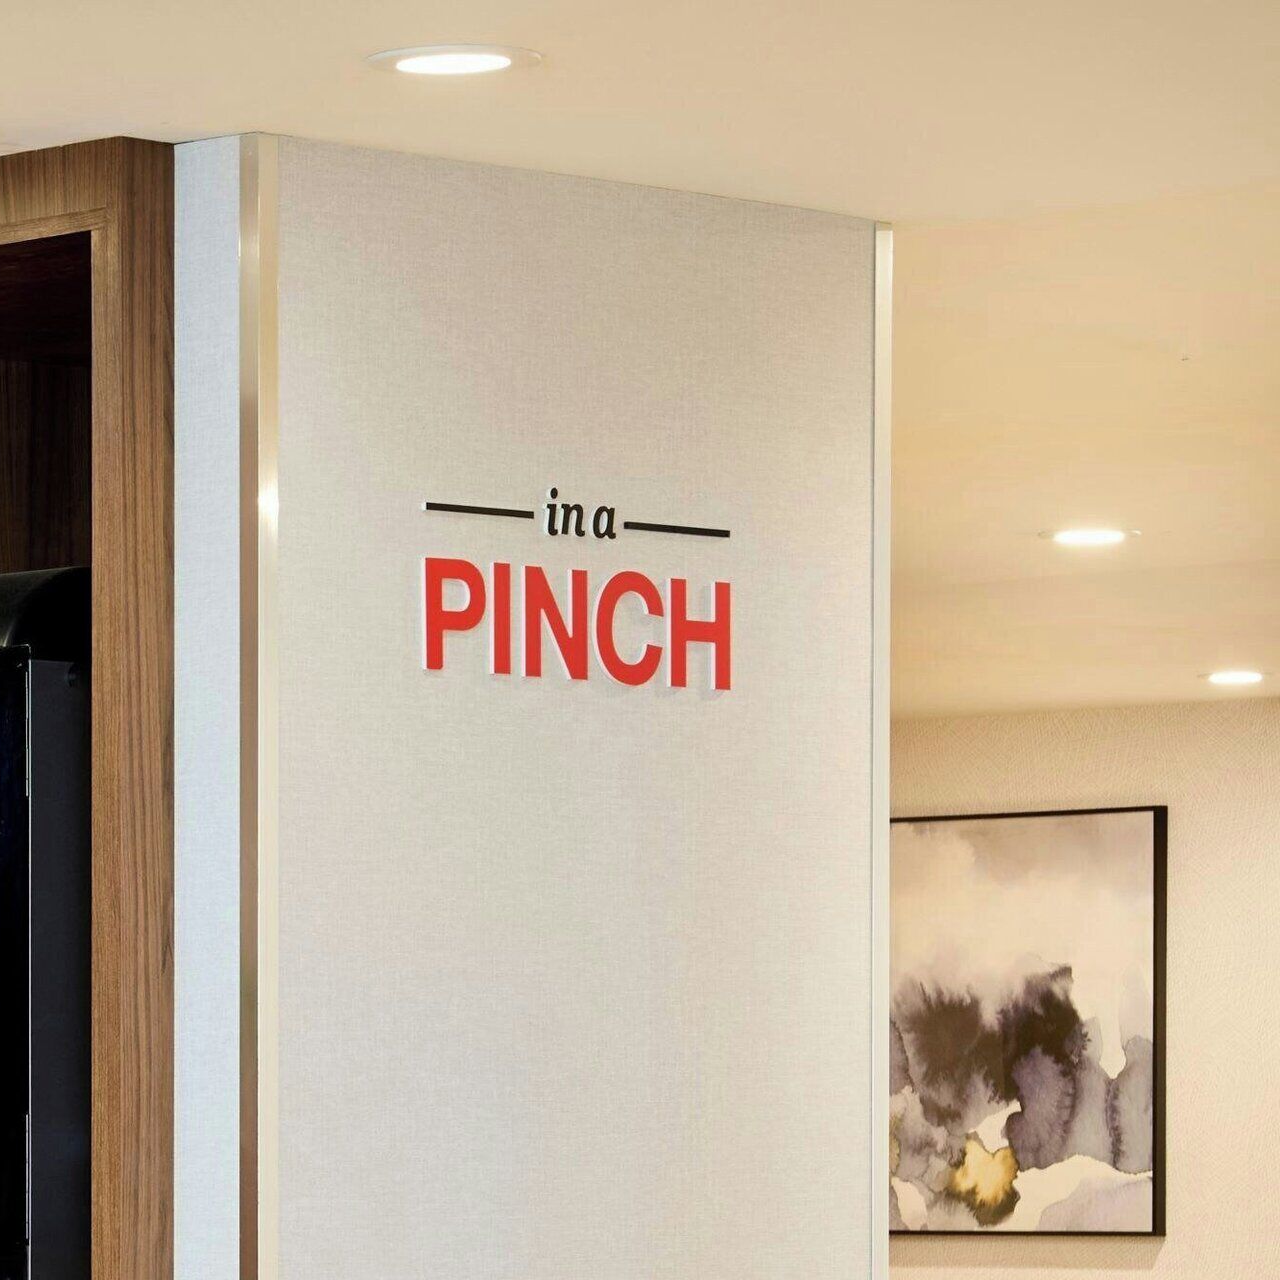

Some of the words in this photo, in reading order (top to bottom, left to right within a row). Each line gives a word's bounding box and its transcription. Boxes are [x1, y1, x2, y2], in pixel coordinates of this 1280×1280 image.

[543, 487, 586, 537] in
[592, 505, 616, 539] a
[421, 557, 731, 691] PINCH
